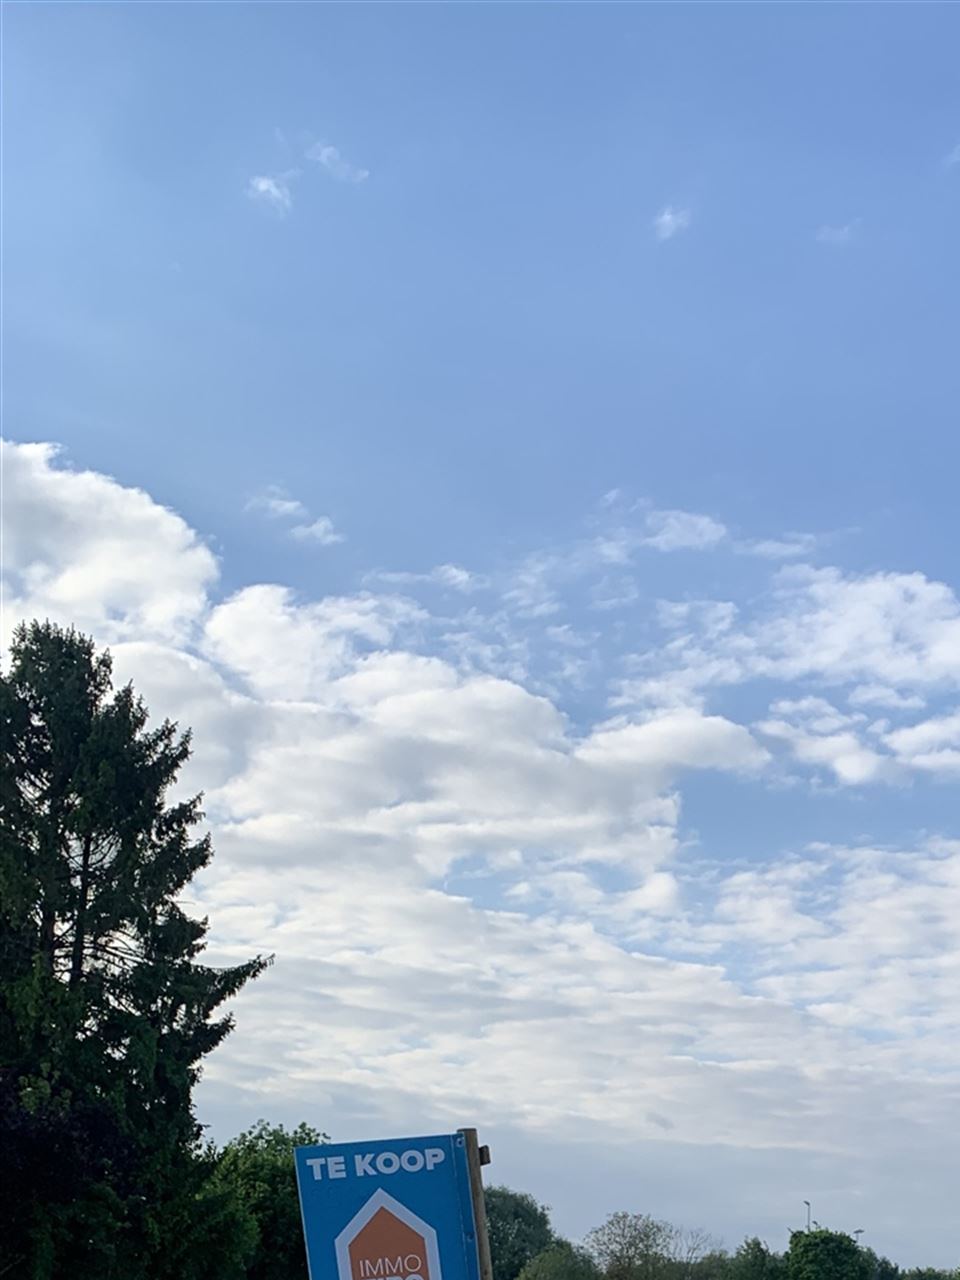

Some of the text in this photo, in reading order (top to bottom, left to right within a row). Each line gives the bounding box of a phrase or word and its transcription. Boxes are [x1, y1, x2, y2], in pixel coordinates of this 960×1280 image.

[306, 1148, 446, 1180] TE KOOP
[359, 1254, 422, 1277] IMMO
